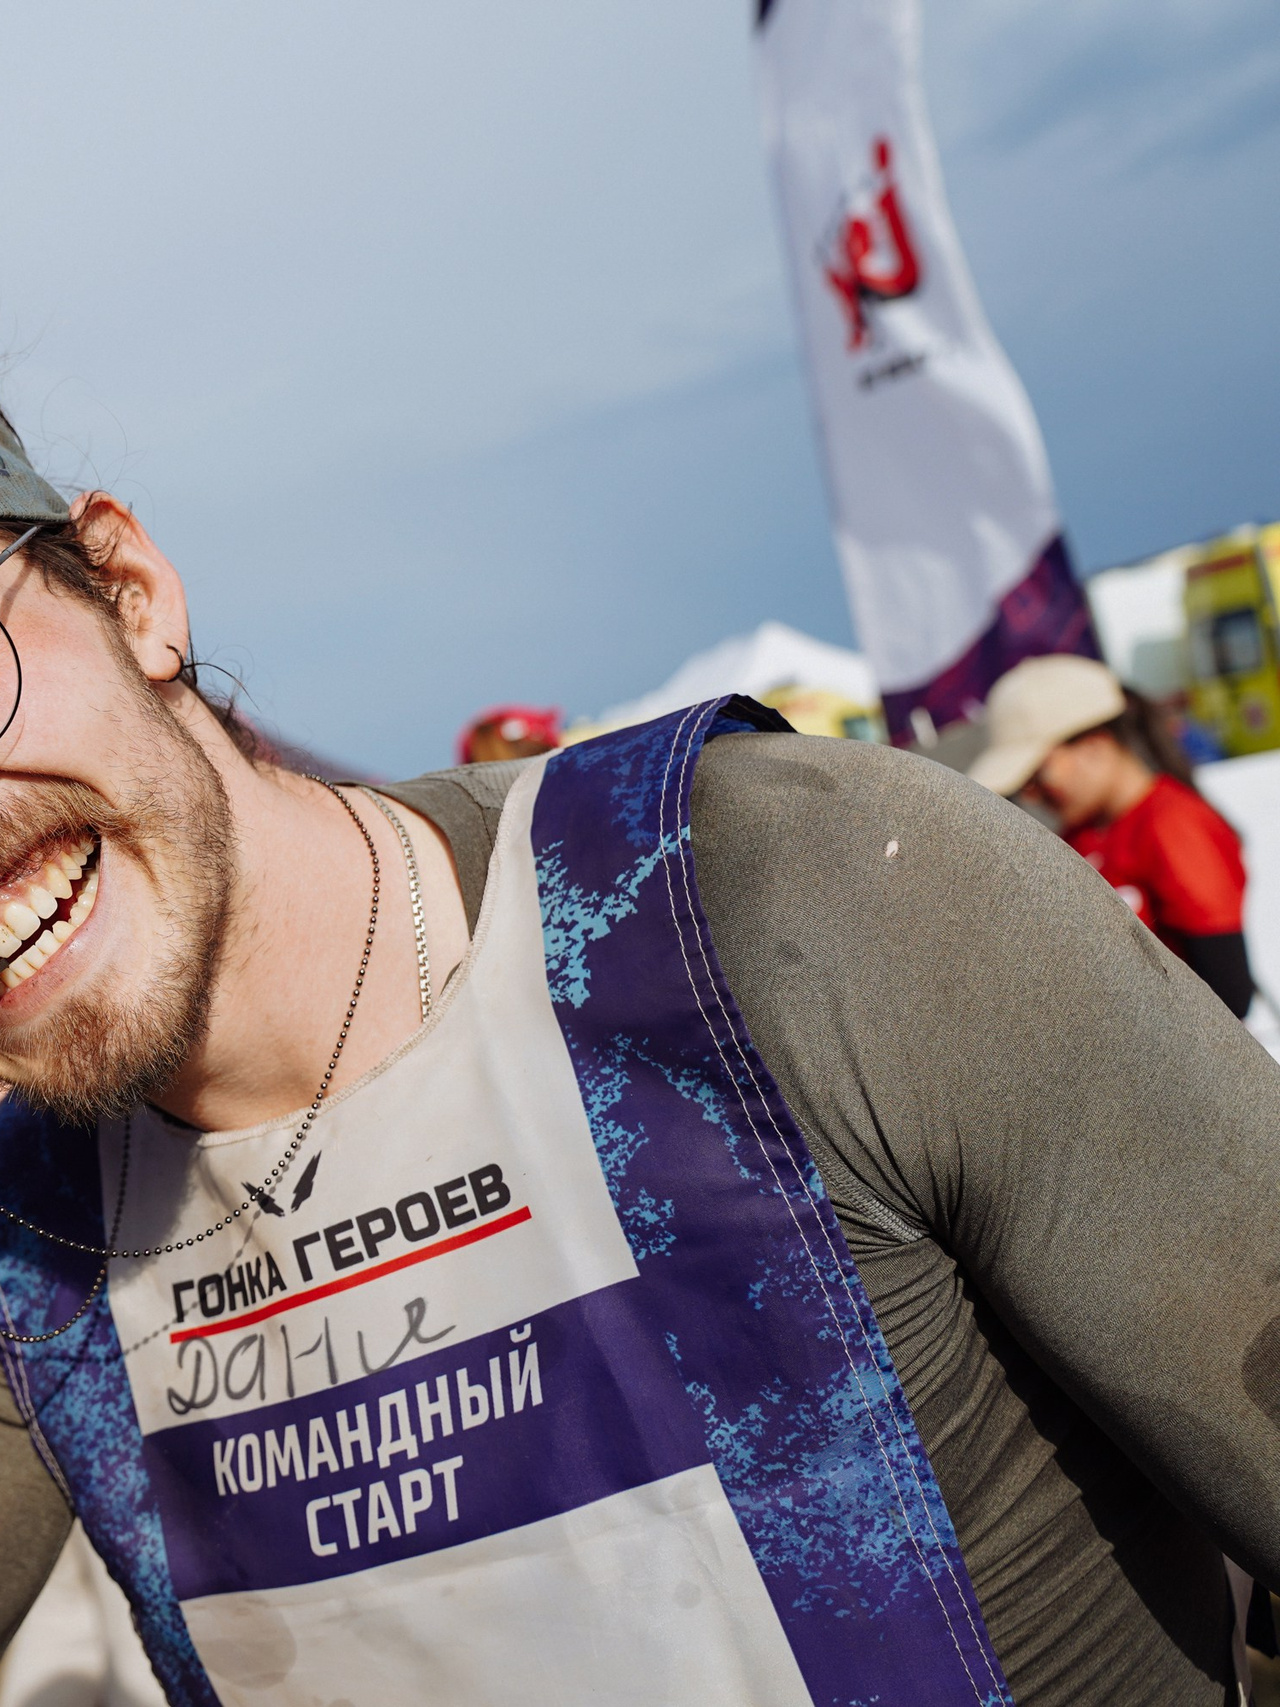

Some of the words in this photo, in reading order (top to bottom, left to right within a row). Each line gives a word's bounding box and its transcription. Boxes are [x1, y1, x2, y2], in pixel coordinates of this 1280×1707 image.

[172, 1252, 287, 1322] ГОНКА
[292, 1163, 512, 1282] ГЕРОЕВ
[213, 1323, 544, 1496] КОМАНДНЫЙ
[305, 1456, 464, 1557] СТАРТ
